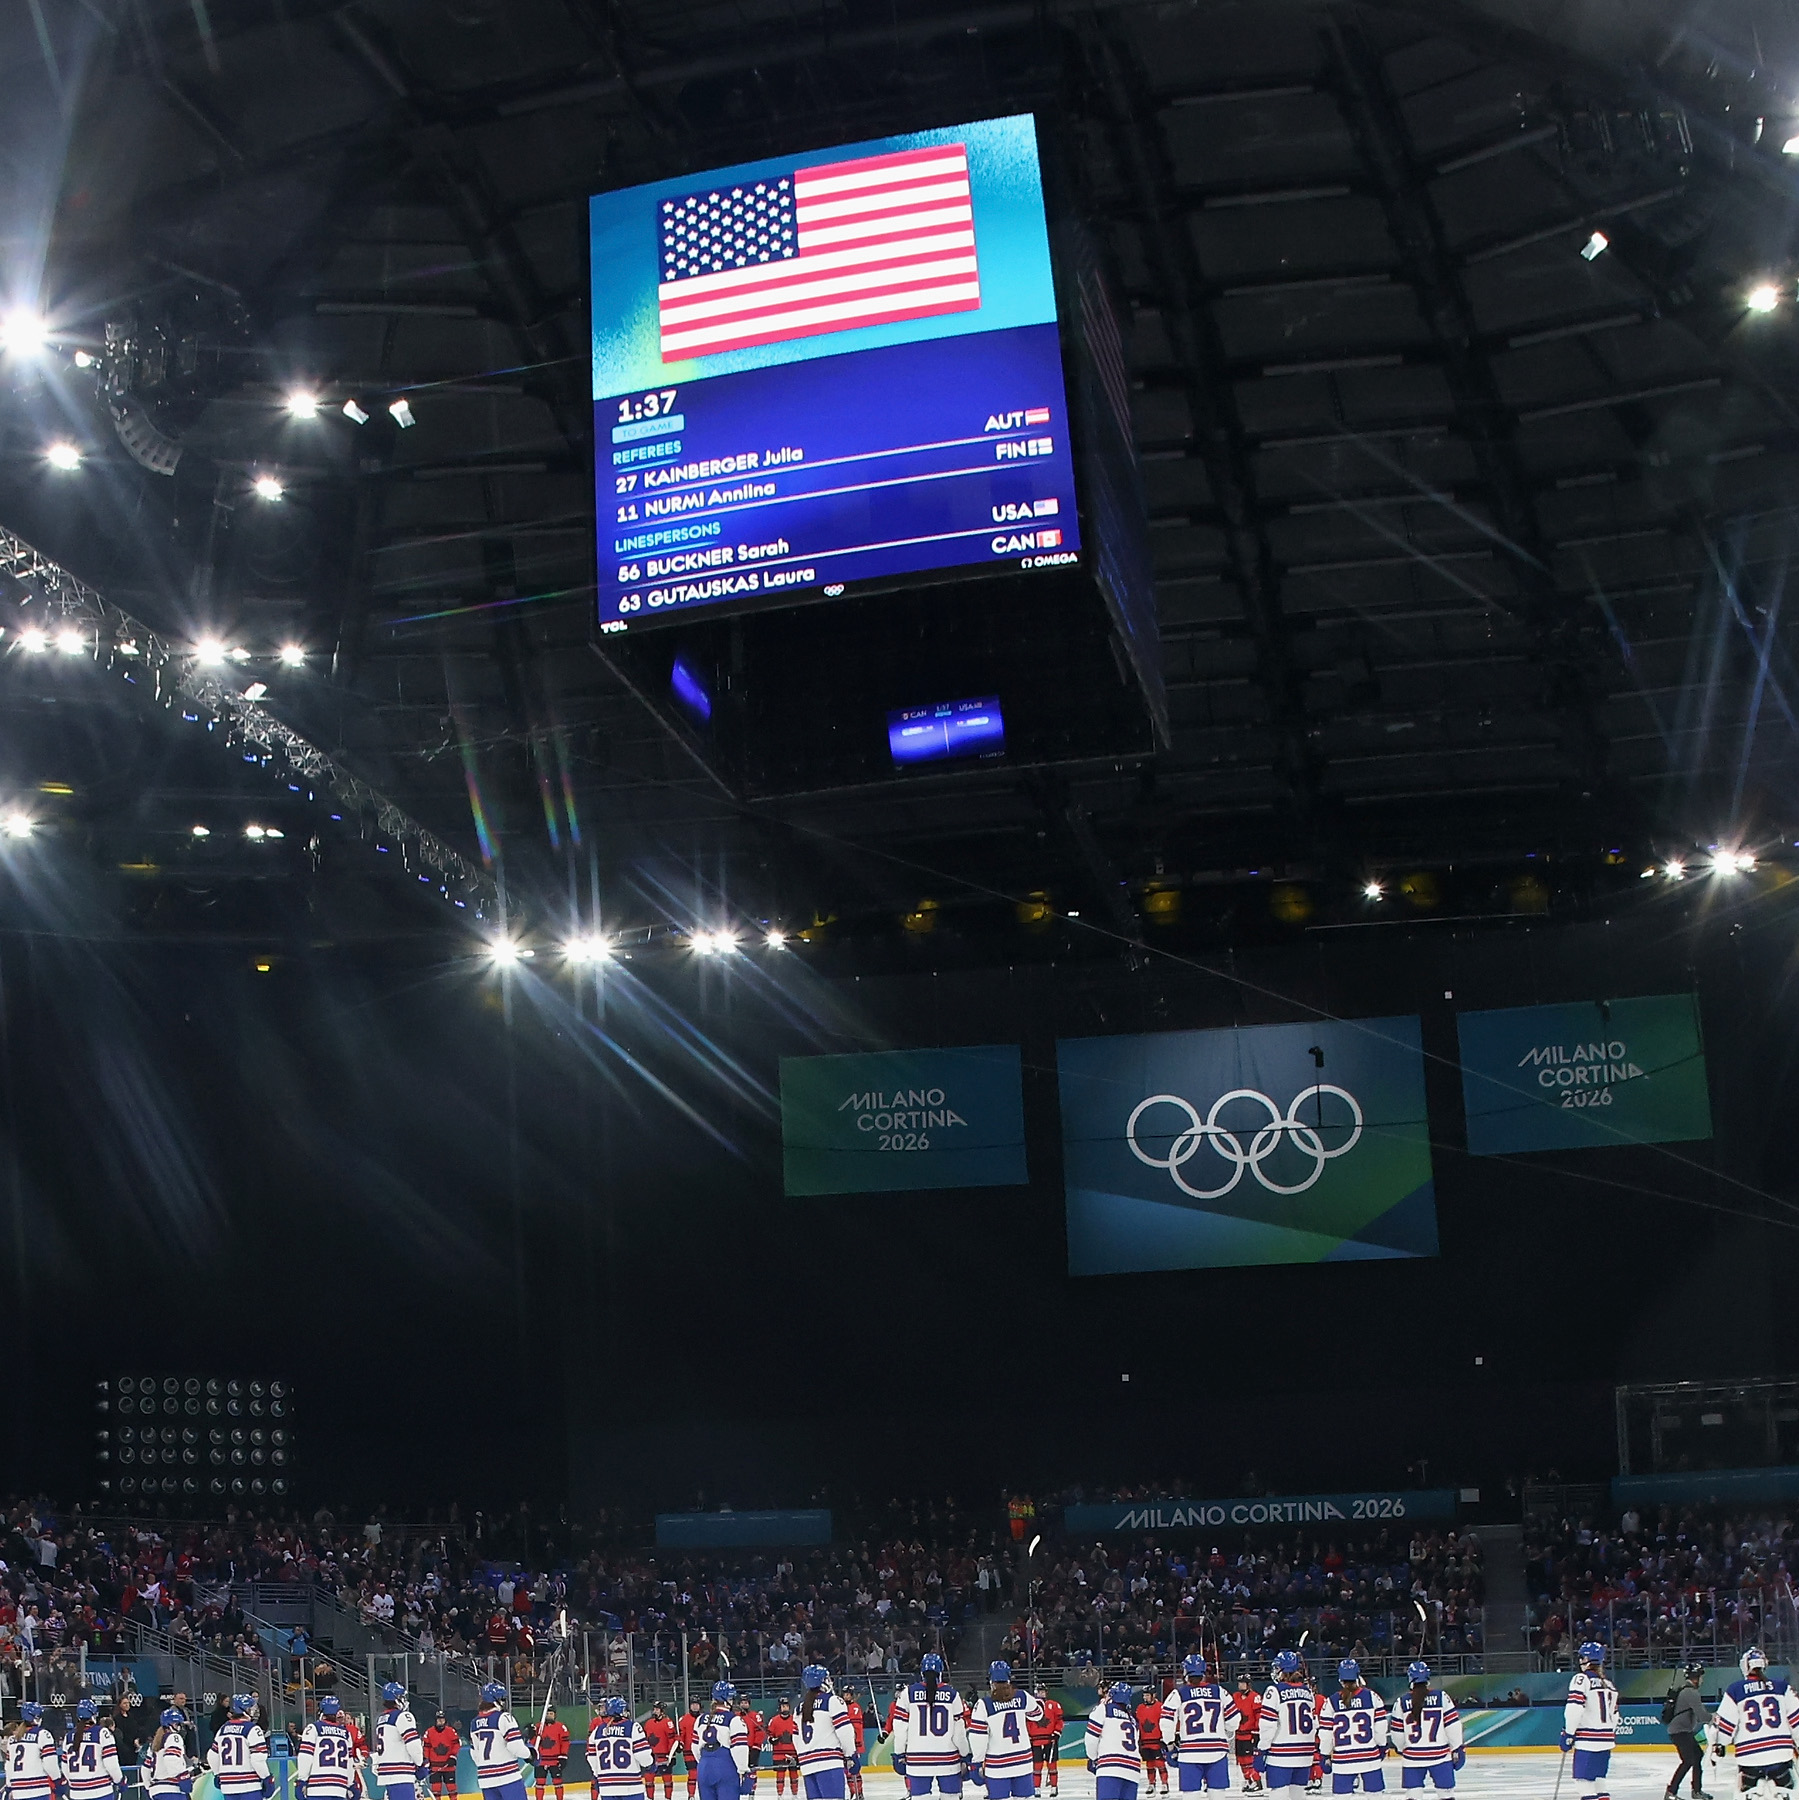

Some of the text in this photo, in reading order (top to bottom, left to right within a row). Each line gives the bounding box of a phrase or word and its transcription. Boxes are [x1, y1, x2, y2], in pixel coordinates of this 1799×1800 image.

[618, 390, 677, 423] 1:37
[622, 421, 673, 438] TO GAME
[984, 411, 1024, 432] AUT
[613, 440, 682, 465] REFEREES
[996, 441, 1026, 460] FIN
[616, 447, 803, 494] 27 KAINBERGER Julia
[617, 483, 776, 523] 11 NURMI Anniina
[992, 503, 1033, 522] USA
[615, 522, 721, 553] LINESPERSONS
[991, 533, 1034, 554] CAN
[618, 538, 790, 583] 56 BUCKNER Sarah
[1034, 552, 1078, 568] OMEGA
[618, 568, 815, 613] 63 GUTAUSKAS Laura
[600, 621, 627, 634] TCL
[1518, 1041, 1626, 1067] MILANO
[1538, 1062, 1650, 1087] CORTINA
[838, 1088, 945, 1111] MILANO
[1560, 1087, 1613, 1108] 2026
[857, 1109, 968, 1131] CORTINA
[878, 1132, 930, 1151] 2026
[1114, 1499, 1406, 1530] MILANO CORTINA 2026
[1190, 1687, 1212, 1698] HEISE
[404, 1713, 412, 1722] 5
[918, 1704, 949, 1736] 10
[1003, 1712, 1021, 1744] 4
[1184, 1700, 1221, 1735] 27
[1286, 1701, 1314, 1735] 16
[1406, 1709, 1442, 1744] 37
[1624, 1716, 1660, 1725] CORTINA
[1743, 1696, 1781, 1732] 33
[1120, 1721, 1137, 1751] 3
[1333, 1712, 1374, 1747] 23
[14, 1744, 26, 1772] 2
[68, 1744, 97, 1773] 24
[221, 1737, 243, 1766] 21
[318, 1738, 348, 1769] 22
[599, 1739, 632, 1770] 26
